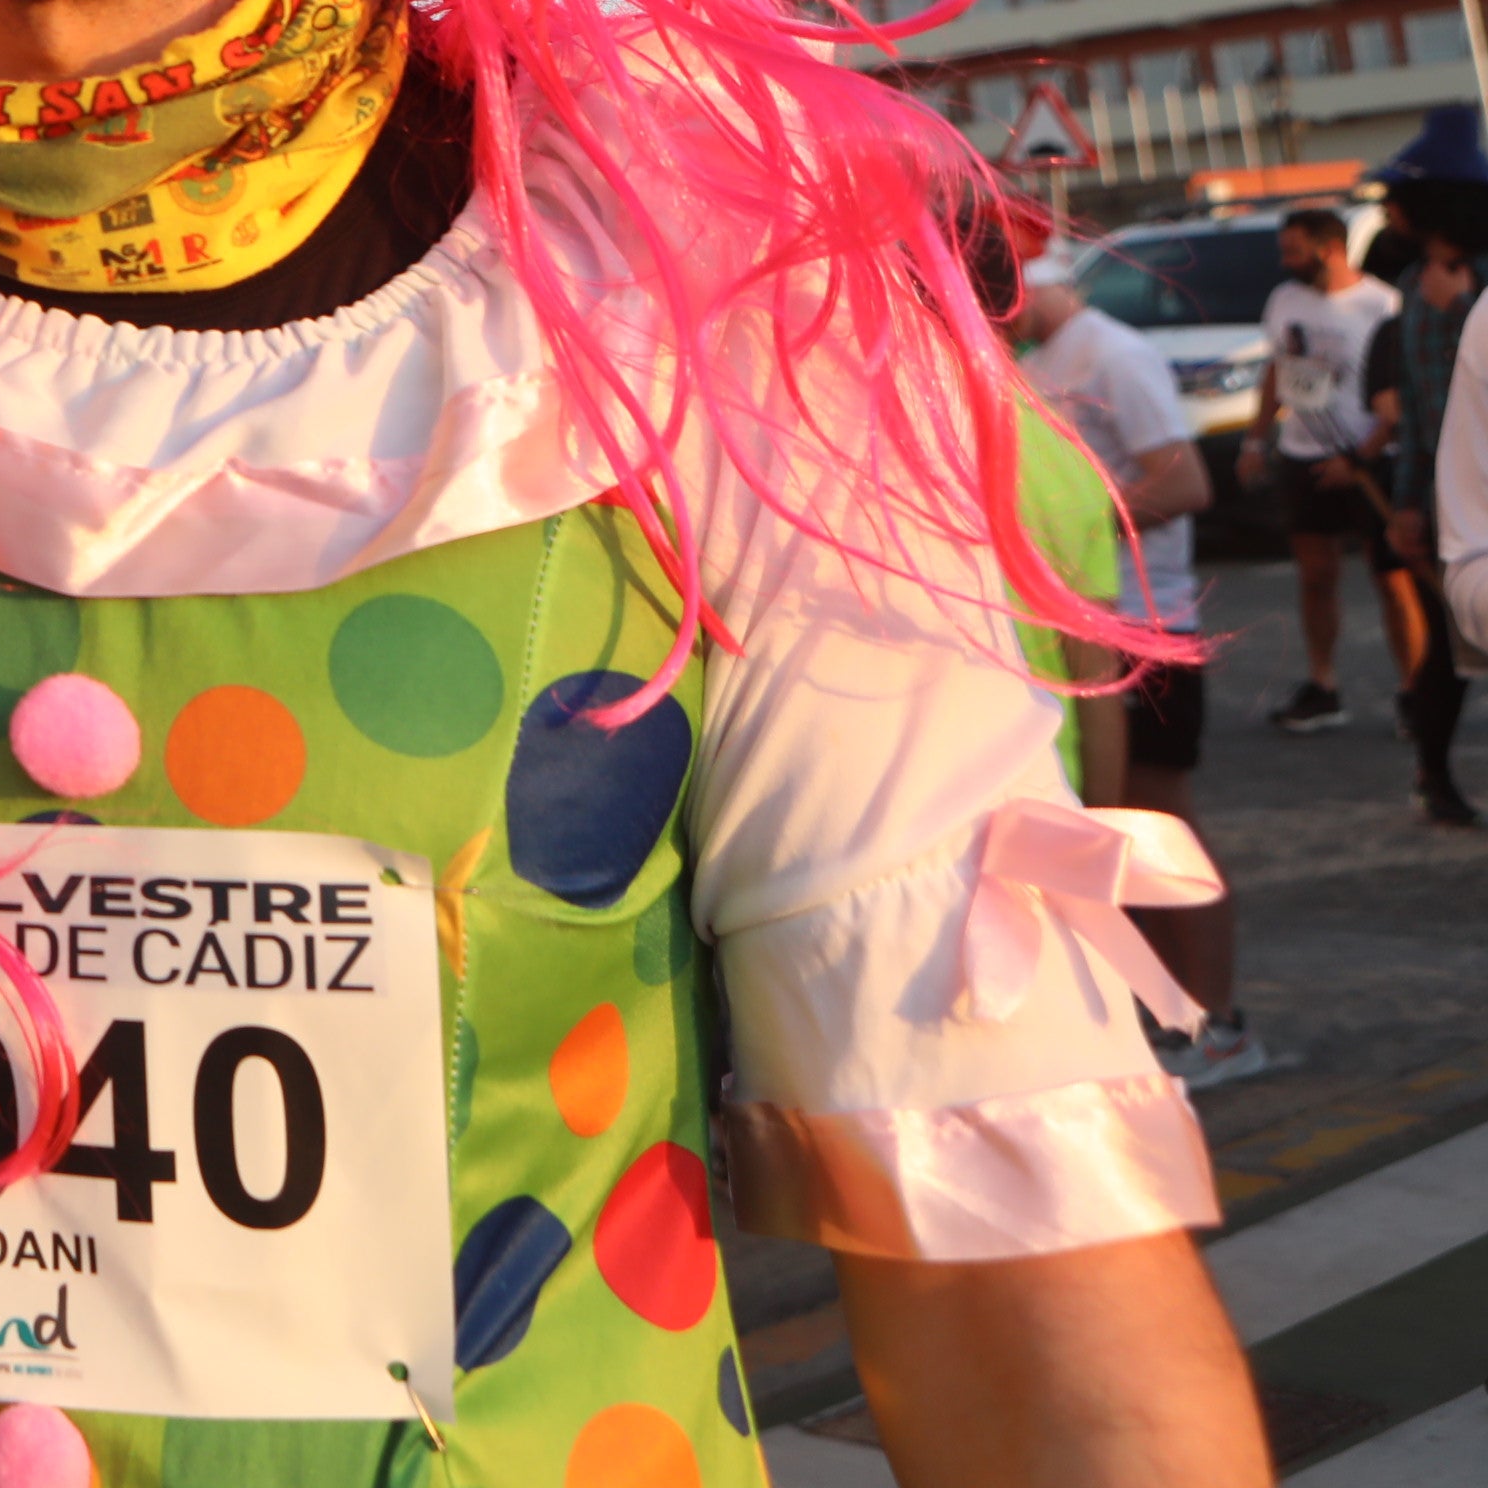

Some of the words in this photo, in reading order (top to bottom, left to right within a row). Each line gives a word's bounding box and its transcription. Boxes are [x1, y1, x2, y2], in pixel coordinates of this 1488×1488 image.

[38, 61, 196, 126] SAN
[16, 921, 109, 982] DE
[132, 914, 376, 994] CÁDIZ
